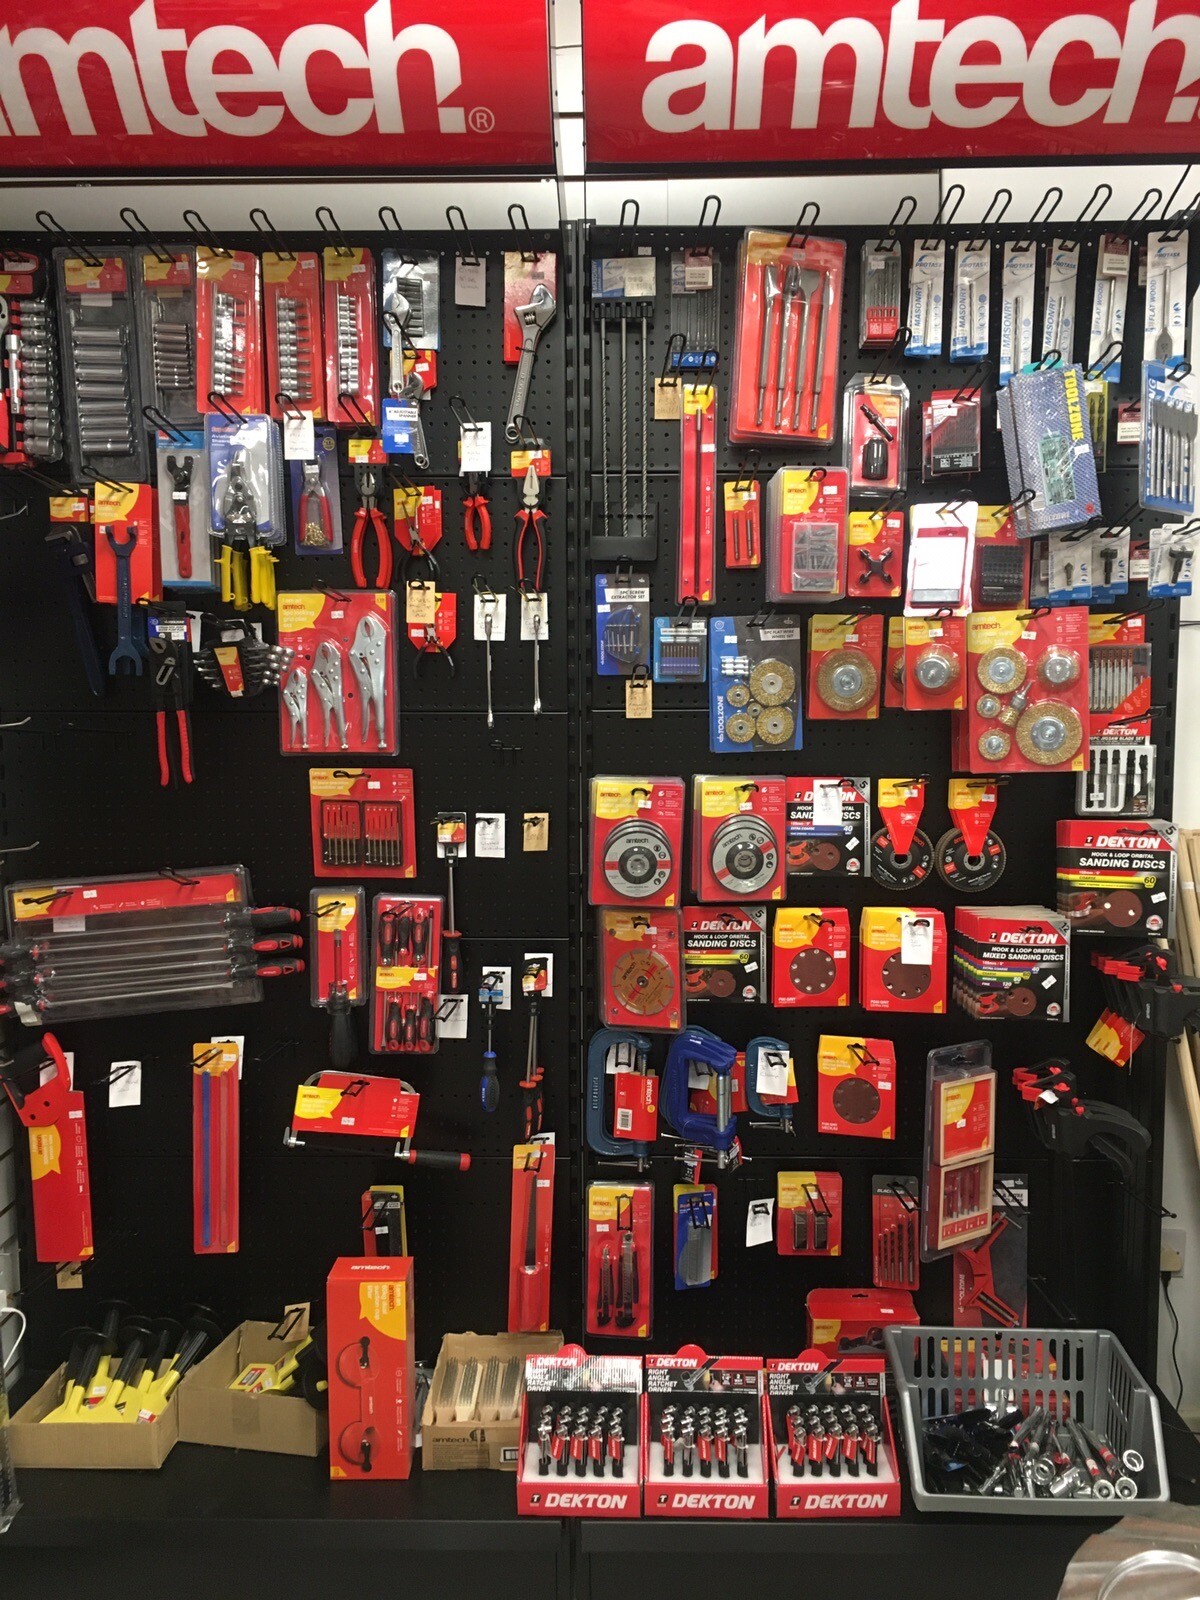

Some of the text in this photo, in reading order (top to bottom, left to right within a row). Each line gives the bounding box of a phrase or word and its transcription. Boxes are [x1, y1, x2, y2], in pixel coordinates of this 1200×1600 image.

[0, 0, 465, 137] mtech
[642, 0, 1200, 133] amtech
[914, 285, 923, 327] MASONRY
[958, 286, 966, 328] MASONRY
[1002, 300, 1012, 348] MASONRY
[1045, 297, 1056, 346] MASONRY
[1064, 369, 1084, 440] TOOLZONE
[972, 622, 1002, 630] amtech
[1166, 826, 1177, 836] 5
[1096, 836, 1161, 849] DEKTON
[1079, 858, 1166, 869] SANDING DISCS
[755, 910, 764, 918] 5
[1000, 933, 1058, 944] DEKTON
[536, 1358, 577, 1366] DEKTON
[656, 1358, 697, 1367] DEKTON
[778, 1362, 819, 1371] DEKTON
[545, 1493, 628, 1509] DEKTON
[672, 1493, 755, 1510] DEKTON
[804, 1494, 888, 1510] DEKTON
